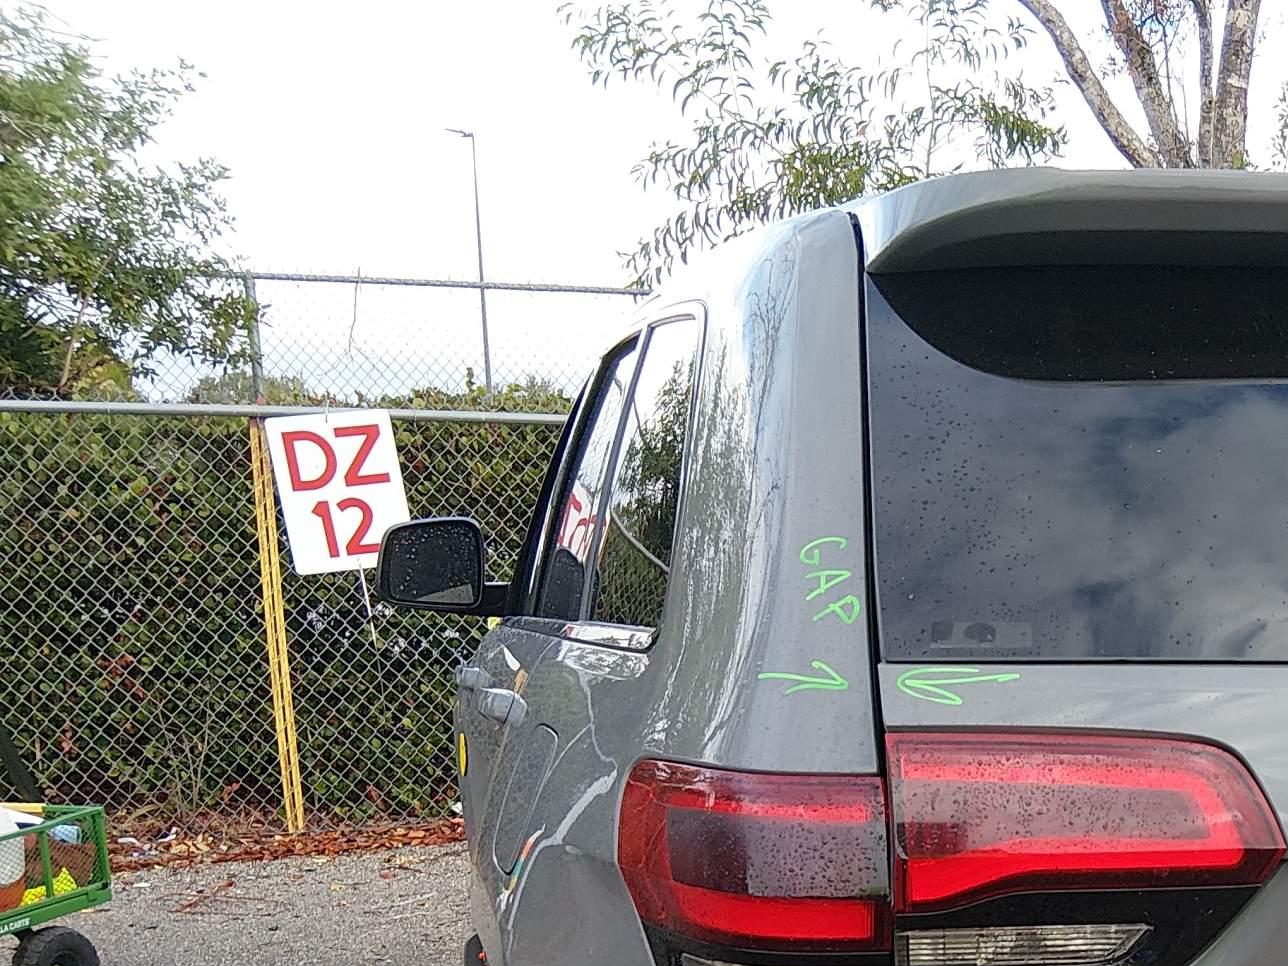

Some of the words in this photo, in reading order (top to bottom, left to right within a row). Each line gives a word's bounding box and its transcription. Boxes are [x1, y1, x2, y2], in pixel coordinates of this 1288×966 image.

[280, 423, 391, 492] DZ
[311, 496, 381, 558] 12
[799, 536, 861, 625] GAP
